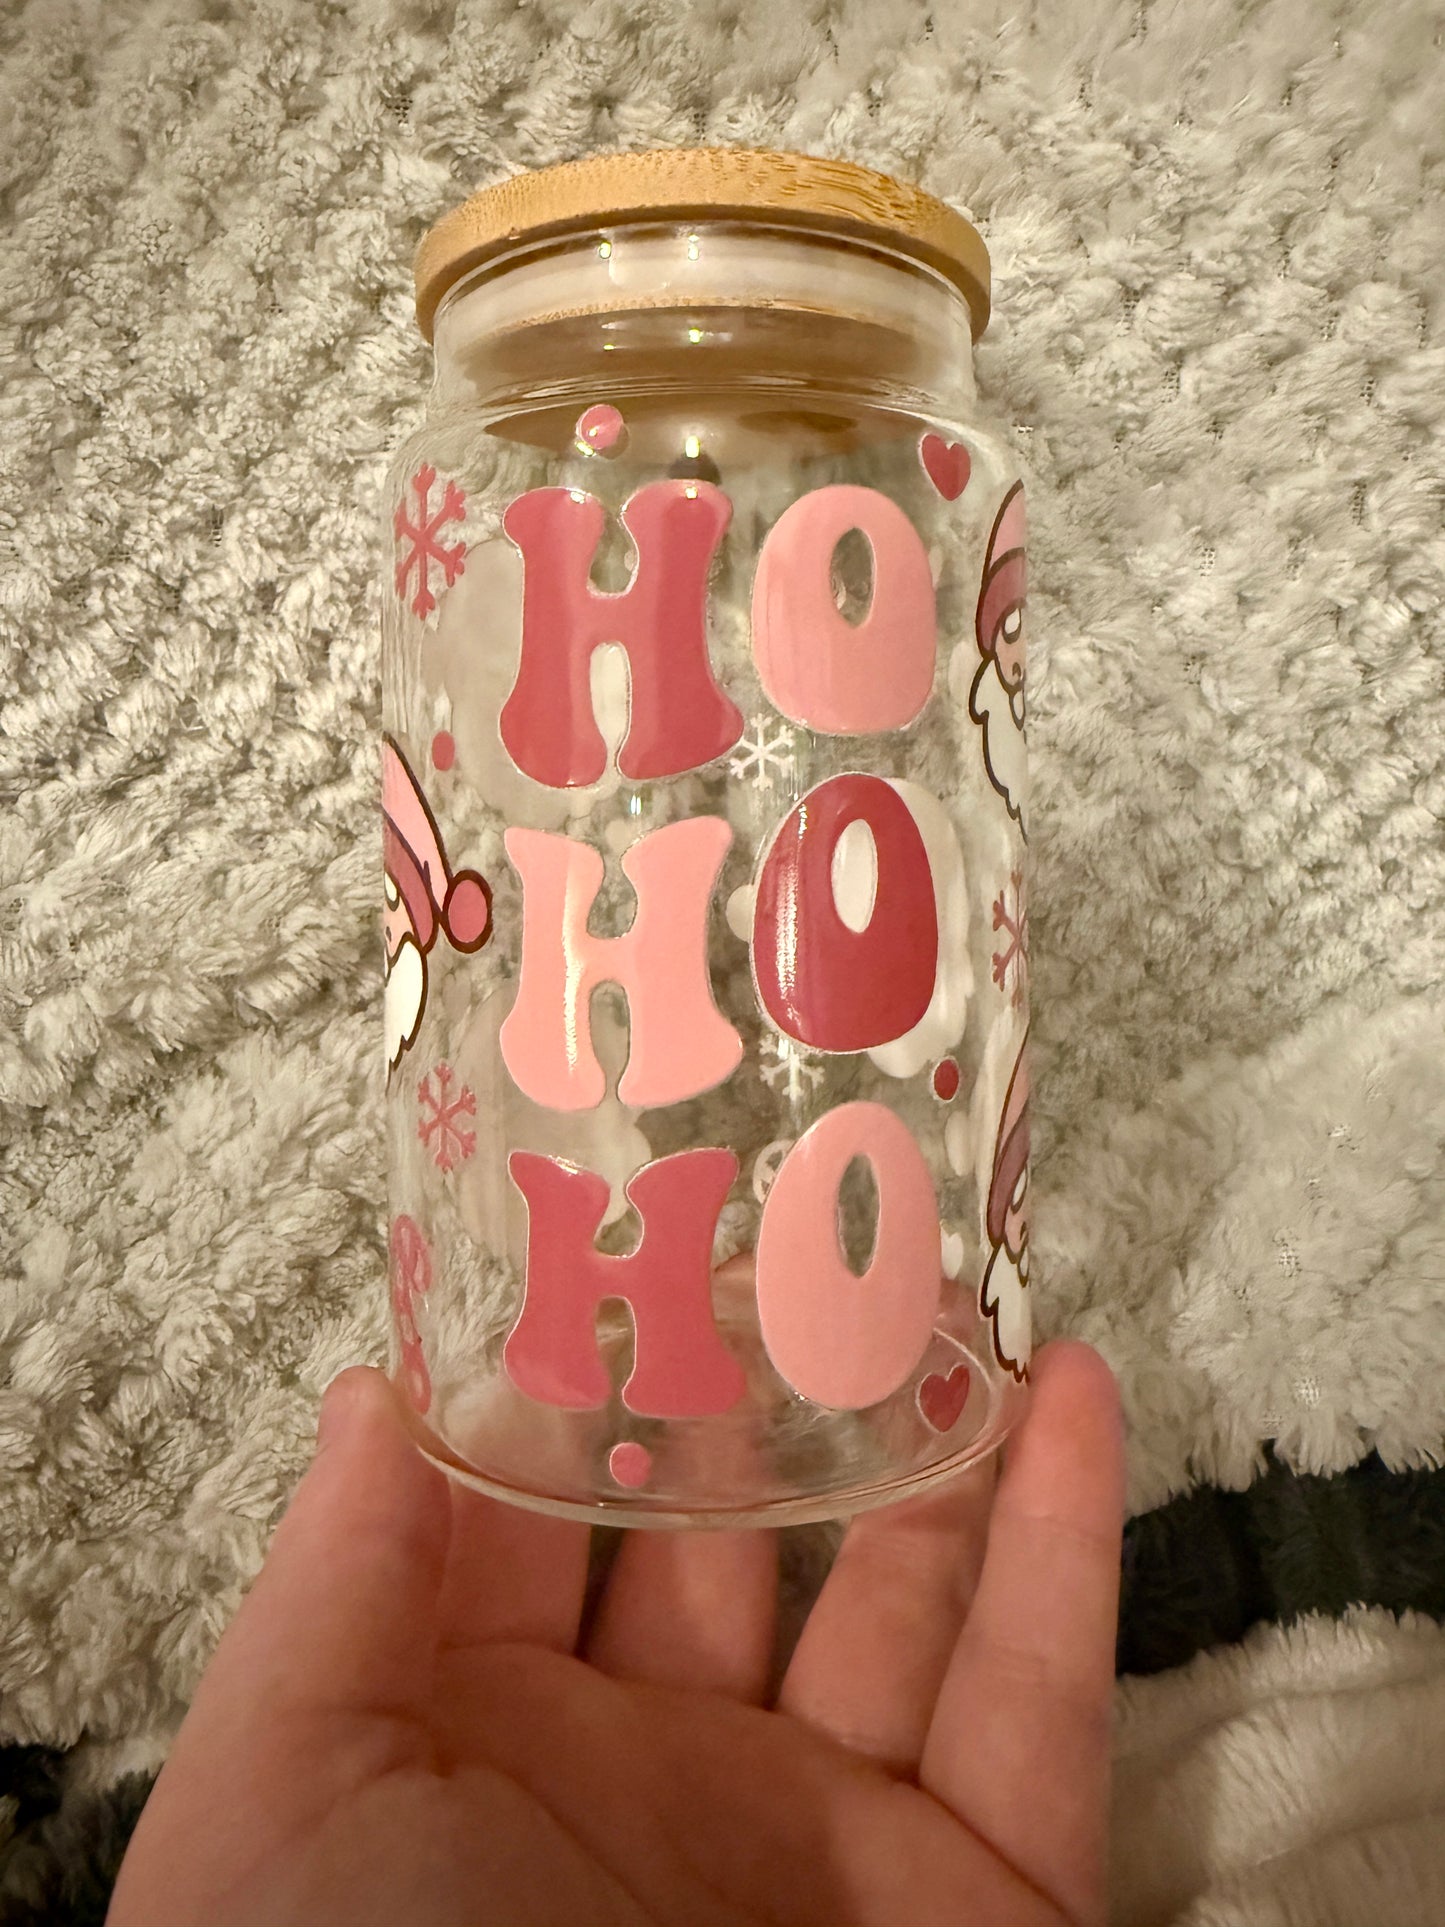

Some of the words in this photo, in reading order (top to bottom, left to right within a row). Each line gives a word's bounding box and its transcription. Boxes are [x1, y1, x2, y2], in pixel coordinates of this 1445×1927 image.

[500, 480, 937, 789] HO
[500, 772, 939, 1111] HO
[504, 1101, 942, 1418] HO
